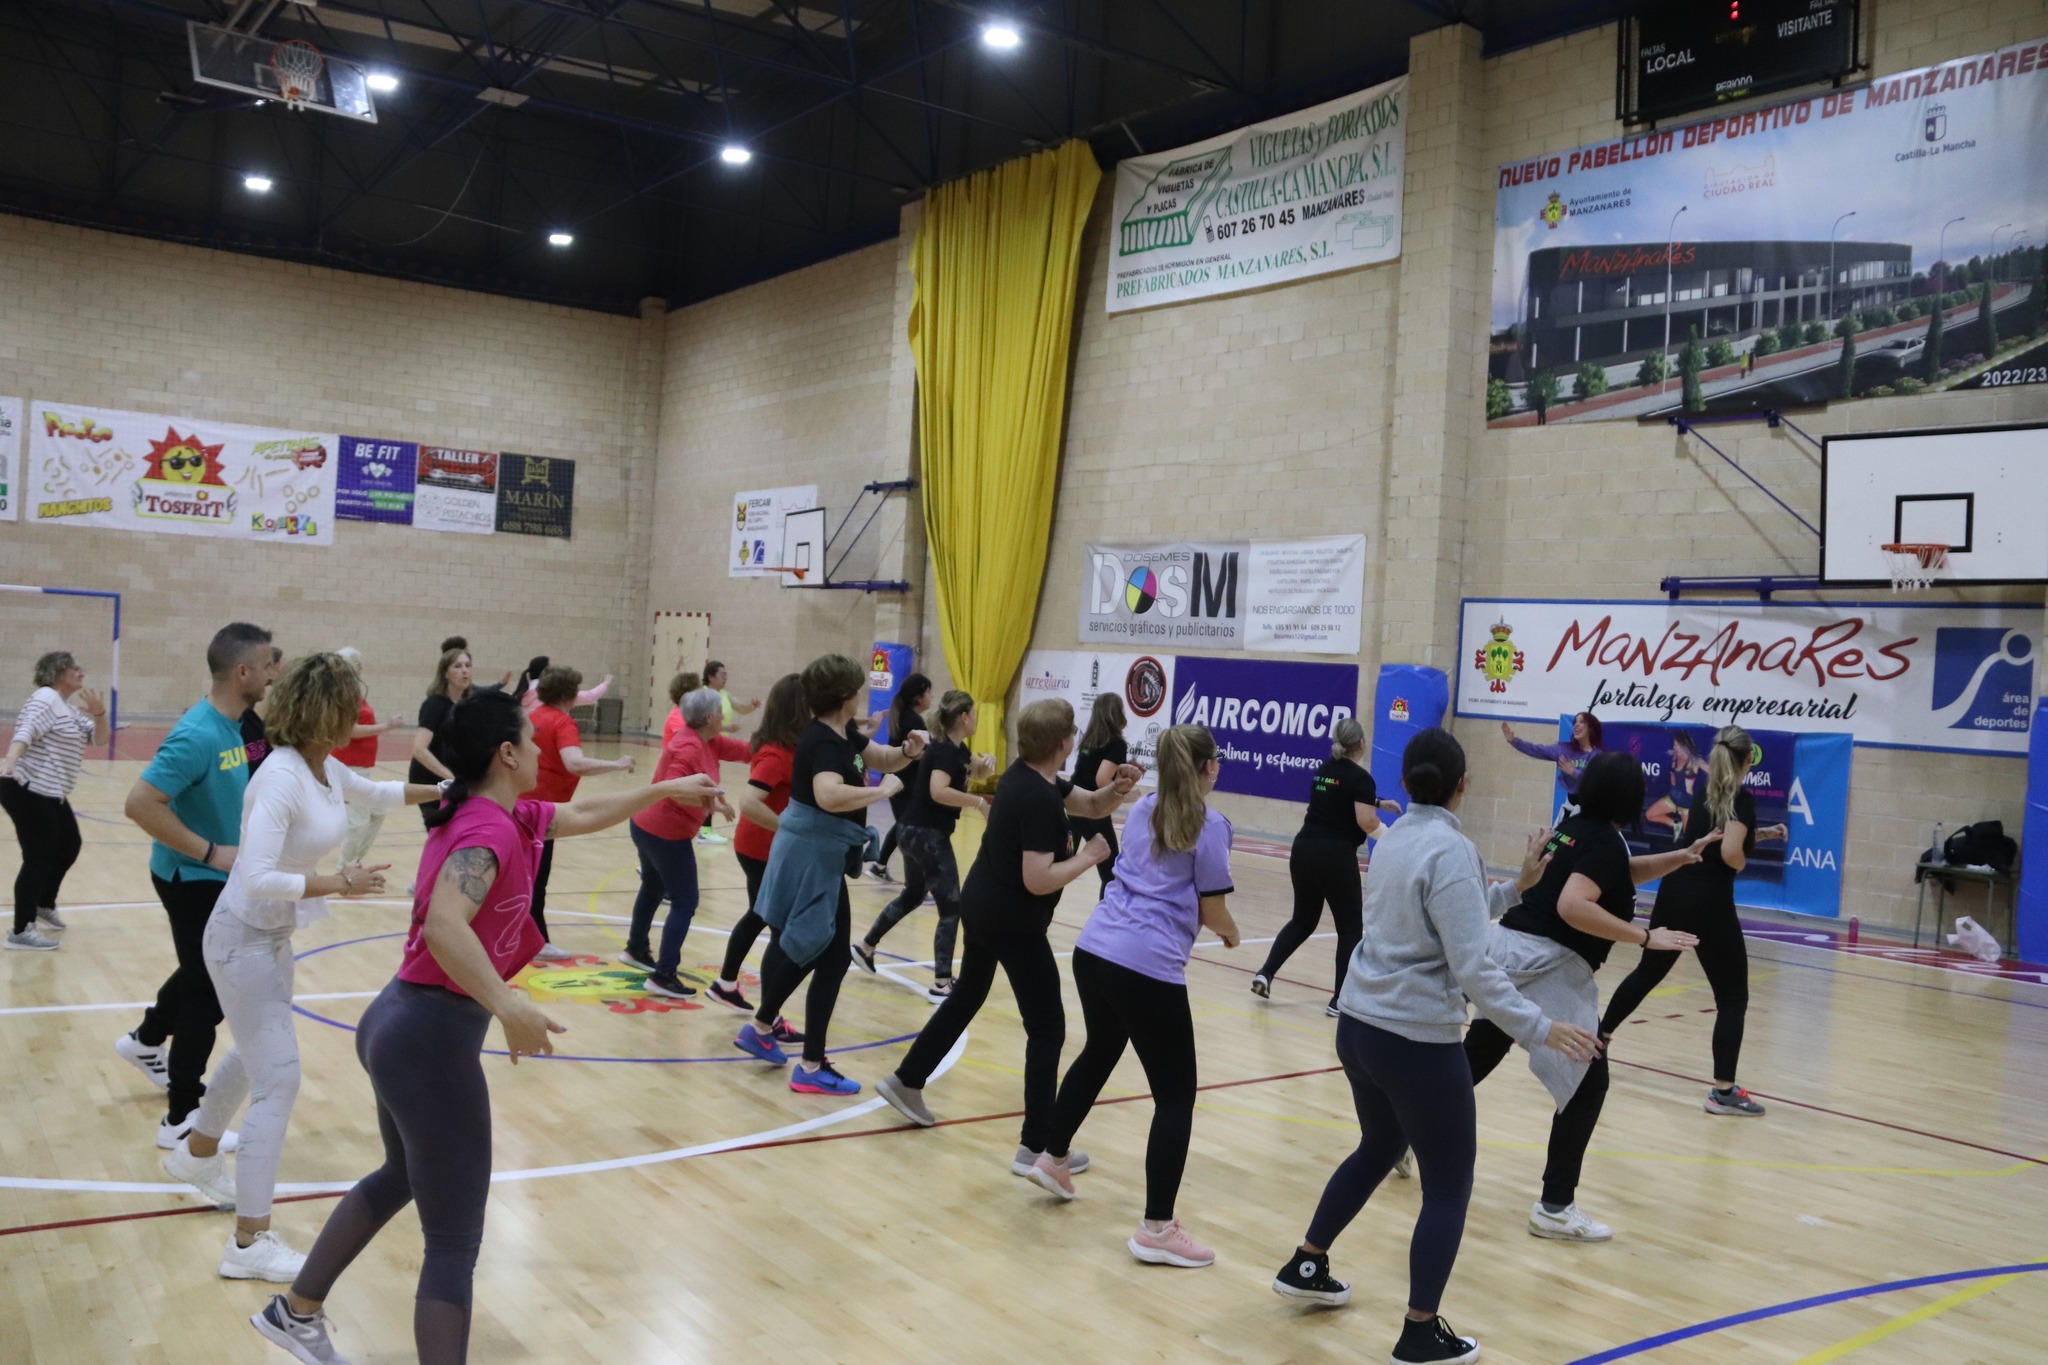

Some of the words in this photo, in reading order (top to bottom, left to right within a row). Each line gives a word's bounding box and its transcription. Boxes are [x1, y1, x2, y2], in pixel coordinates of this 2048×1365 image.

[1777, 10, 1832, 37] VISITANTE
[1646, 48, 1695, 74] LOCAL
[1499, 157, 1560, 189] NUEVO
[1567, 132, 1674, 174] PABELLON
[1682, 100, 1811, 149] DEPORTIVO
[1821, 90, 1857, 119] DE
[1864, 42, 2048, 110] MANZANARES
[1250, 121, 1317, 169] VIGUETAS
[1326, 92, 1401, 147] FORJADOS
[1895, 147, 1940, 163] Castilla-La
[1943, 138, 1976, 153] Mancha
[1204, 158, 1215, 170] DE
[1157, 178, 1195, 195] VIGUETAS
[1703, 183, 1745, 199] CIUDAD
[1748, 178, 1774, 190] REAL
[1146, 205, 1153, 214] Y
[1153, 198, 1177, 214] PLACAS
[1569, 189, 1620, 206] Ayuntamiento
[1621, 187, 1632, 197] de
[1217, 221, 1238, 240] 607
[1241, 217, 1256, 235] 26
[1259, 213, 1275, 231] 70
[1279, 208, 1296, 226] 45
[1302, 189, 1365, 221] MANZANARES
[1569, 198, 1632, 217] MANZANARES
[1116, 265, 1158, 279] PREFABRICADOS
[1158, 263, 1165, 271] DE
[1204, 253, 1232, 264] GENERAL
[1116, 265, 1211, 298] PREFABRICADOS
[1982, 366, 2048, 387] 2022/23
[354, 442, 375, 458] BE
[377, 445, 401, 460] FIT
[437, 449, 480, 464] TALLER
[145, 495, 224, 518] TOSFRIT
[504, 490, 565, 509] MARÍN
[1123, 552, 1190, 562] DOSEMES
[1252, 605, 1268, 615] NOS
[1269, 605, 1321, 615] ENCARGAMOS
[1322, 605, 1333, 615] DE
[1334, 605, 1355, 615] TODO
[1089, 619, 1128, 633] servicios
[1129, 619, 1166, 637] gráficos
[1168, 625, 1175, 638] y
[1176, 622, 1235, 638] publicitarios
[1586, 678, 1695, 722] fortaleza
[1702, 692, 1859, 724] empresarial
[2002, 692, 2029, 704] área
[2013, 705, 2029, 716] de
[1974, 715, 2028, 729] deportes
[1253, 752, 1262, 771] y
[1784, 846, 1837, 871] ANA
